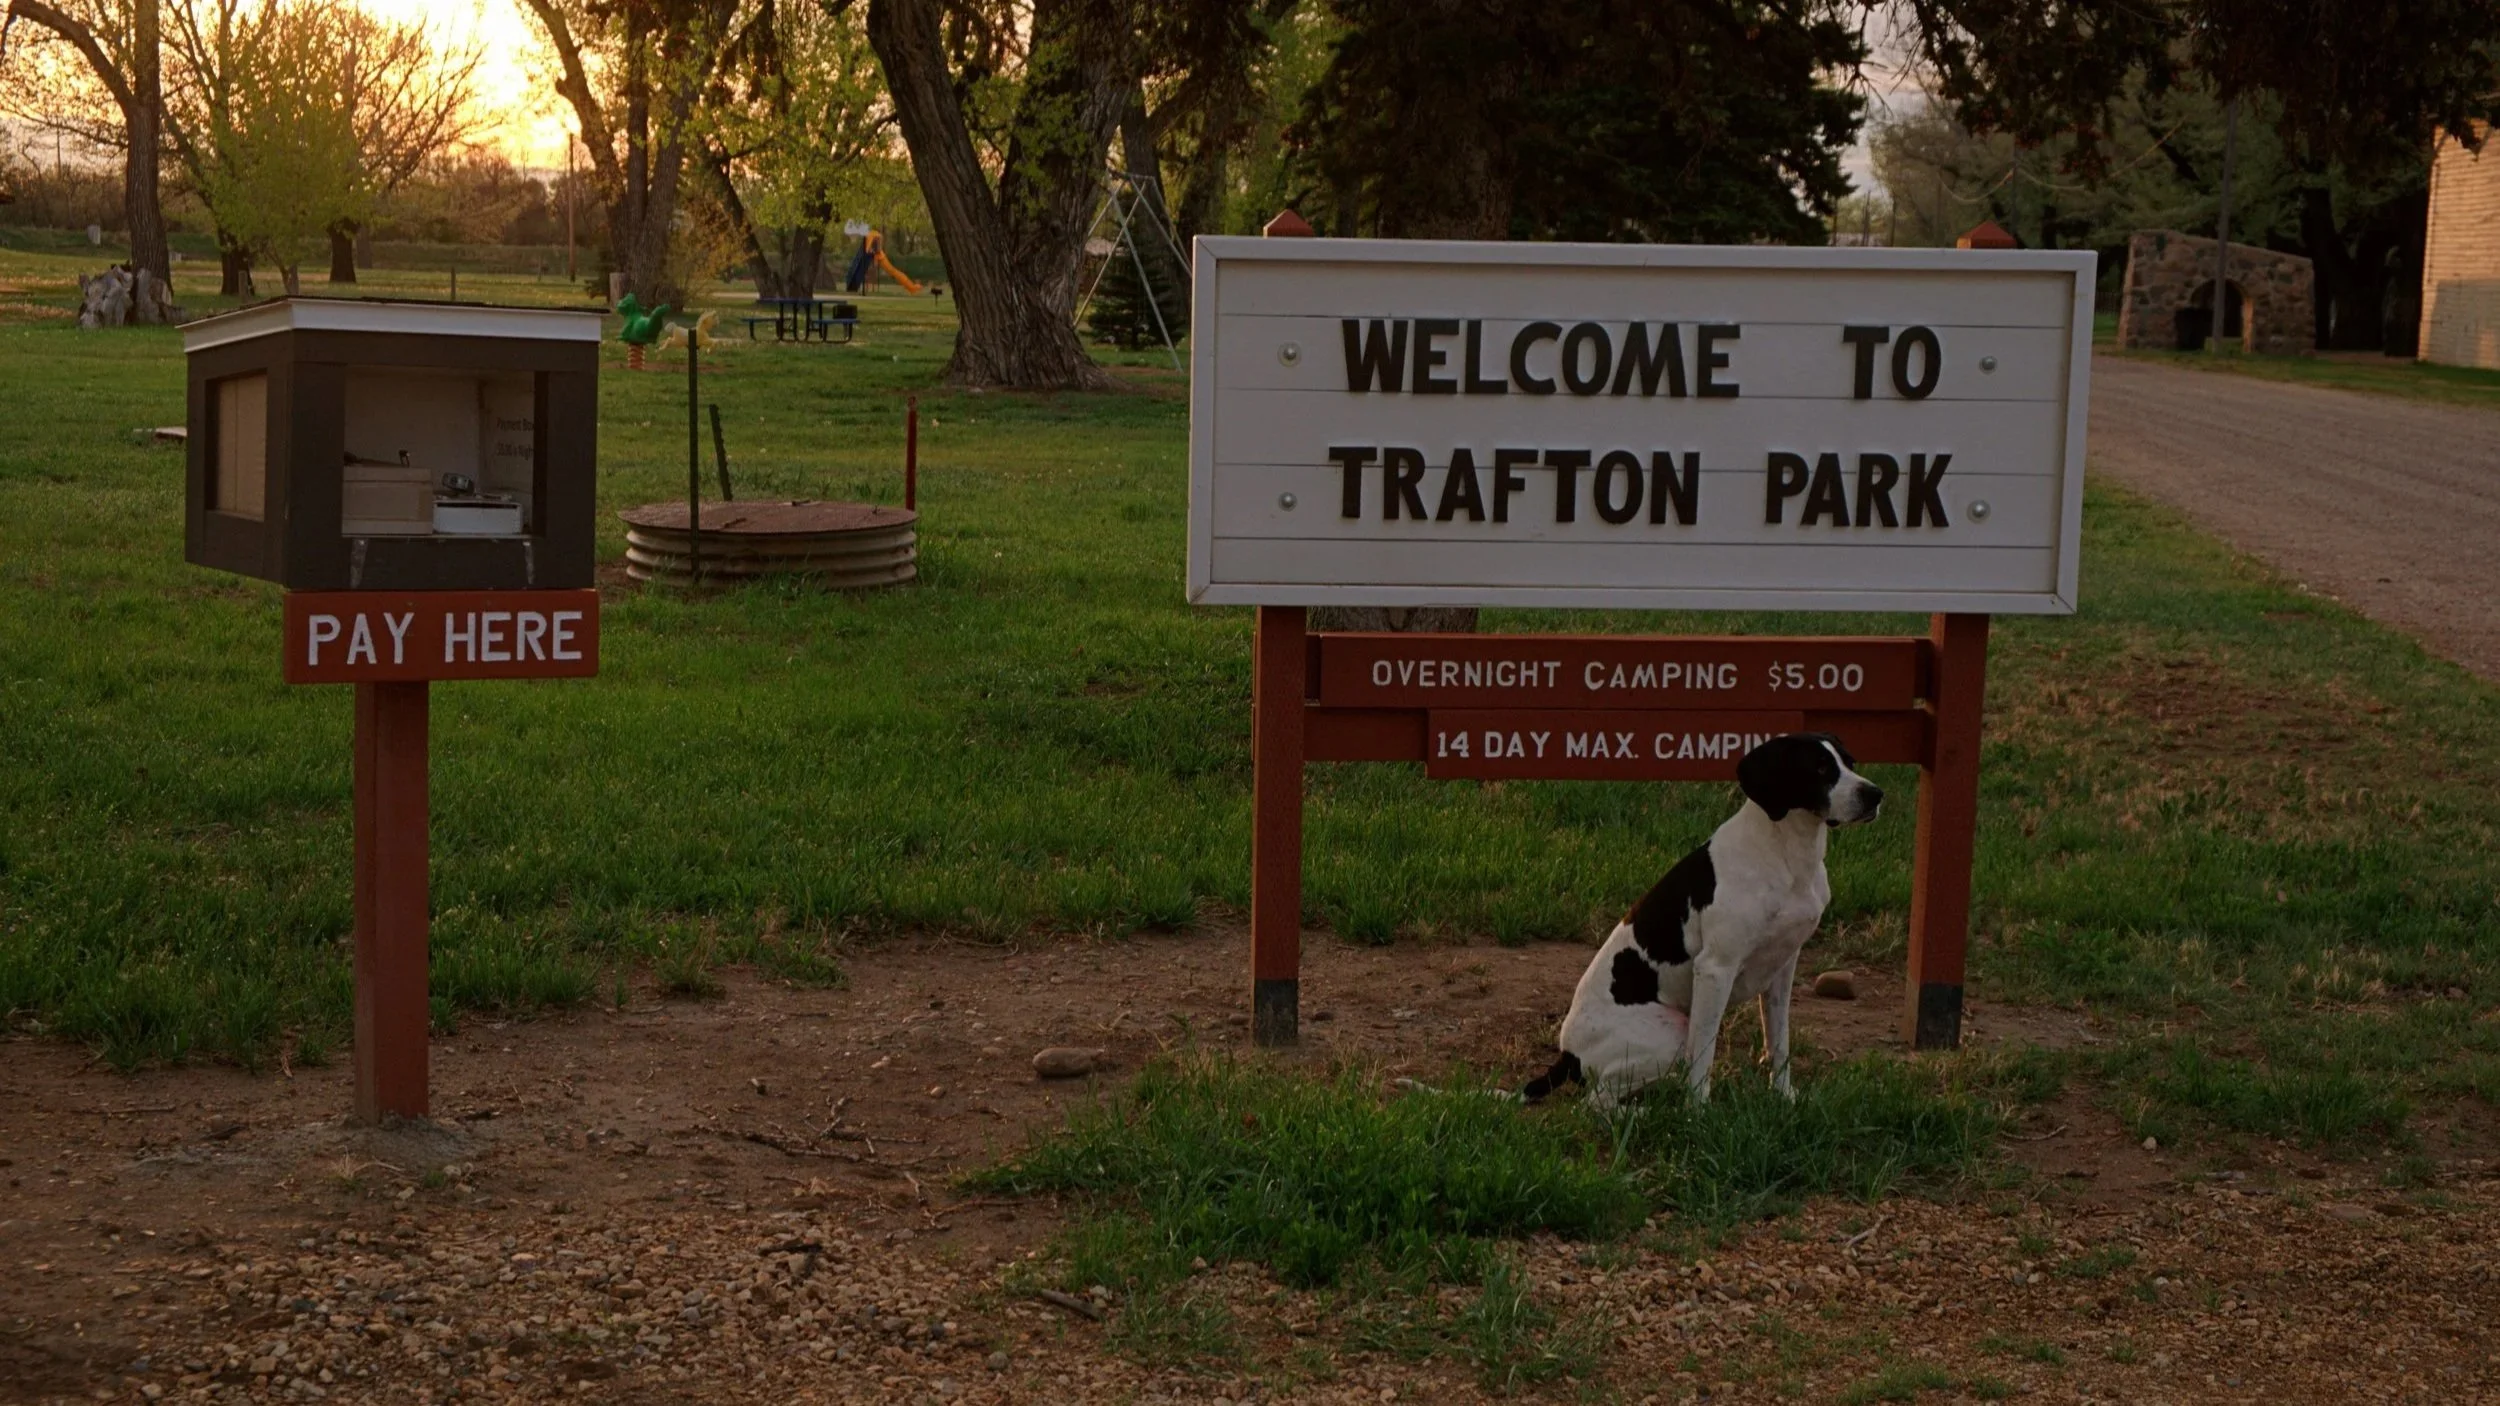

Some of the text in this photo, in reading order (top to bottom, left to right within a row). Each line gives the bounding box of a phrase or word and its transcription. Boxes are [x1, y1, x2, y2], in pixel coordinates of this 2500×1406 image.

[1341, 318, 1943, 402] WELCOME TO
[1328, 446, 1952, 529] TRAFTON PARK
[308, 610, 583, 667] PAY HERE
[1372, 659, 1864, 692] OVERNIGHT CAMPING $5.00
[1437, 730, 1790, 760] 14 DAY MAX. CAMPI
